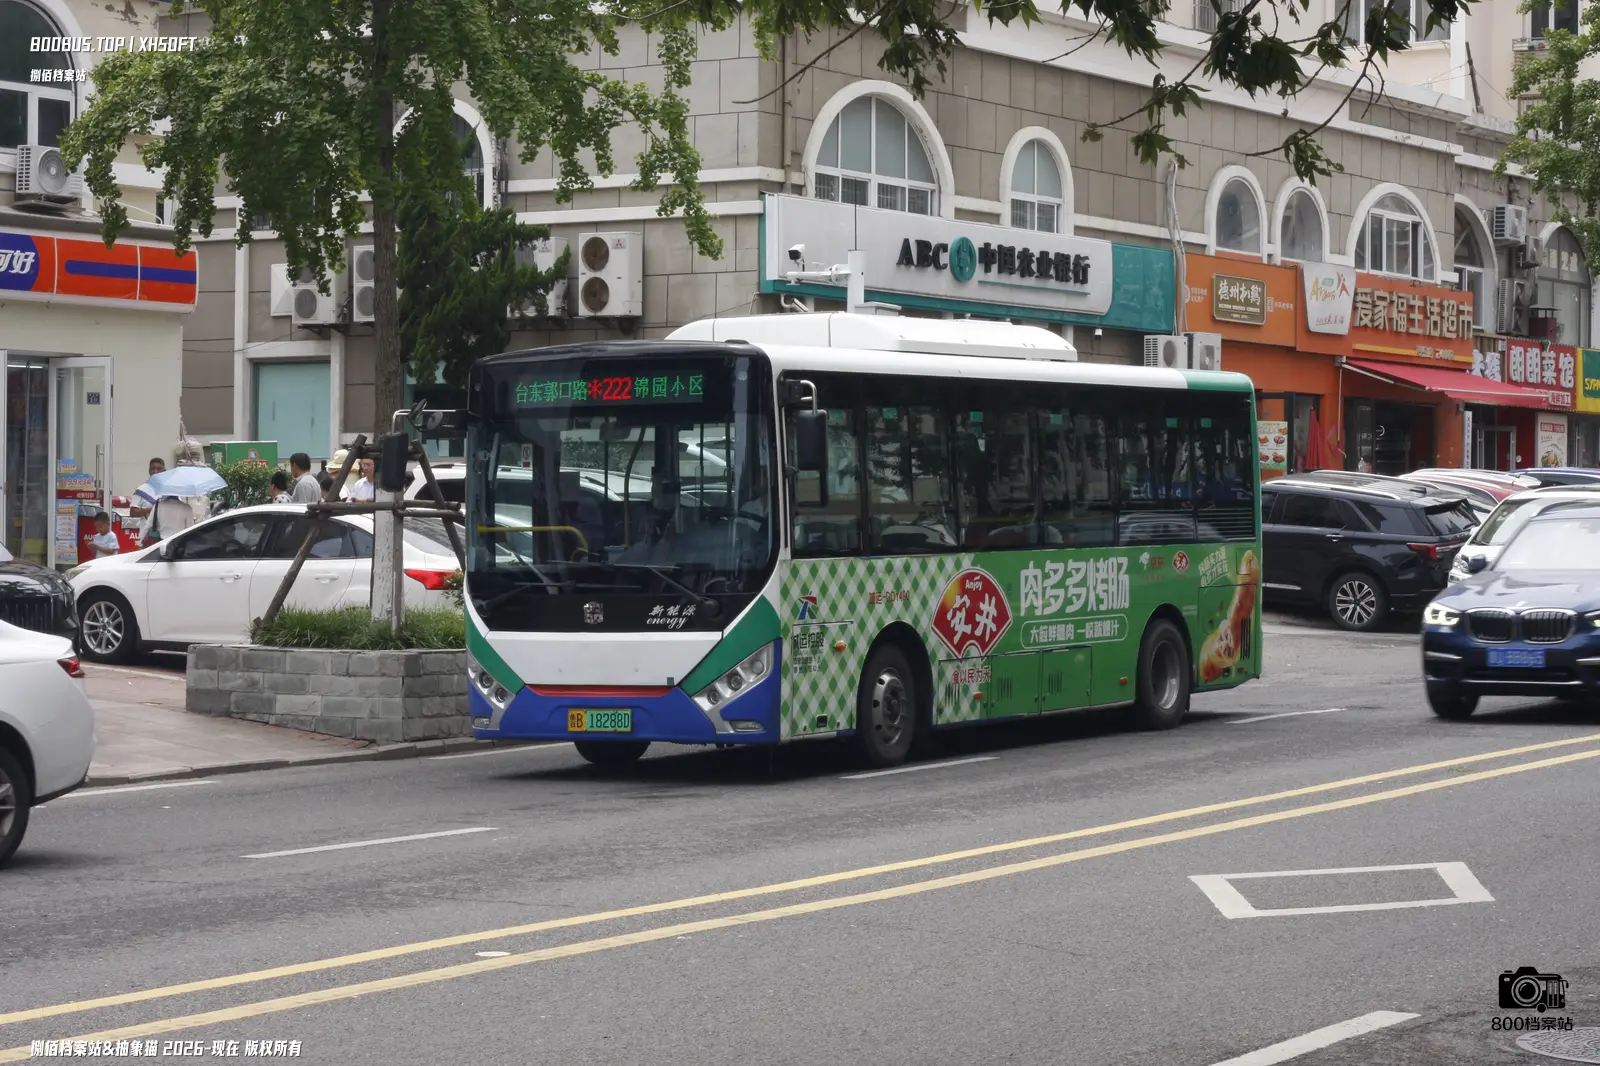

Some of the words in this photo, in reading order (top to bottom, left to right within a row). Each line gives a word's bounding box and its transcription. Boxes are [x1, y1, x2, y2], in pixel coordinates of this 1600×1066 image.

[896, 238, 949, 270] ABC
[978, 242, 1092, 285] 中国农业银行
[1354, 287, 1474, 340] 爱家福生活超市
[965, 579, 983, 591] Anjoy
[1020, 557, 1130, 616] 肉多多烤肠
[646, 616, 689, 629] energy
[649, 604, 697, 616] 新能源
[946, 593, 998, 644] 安井
